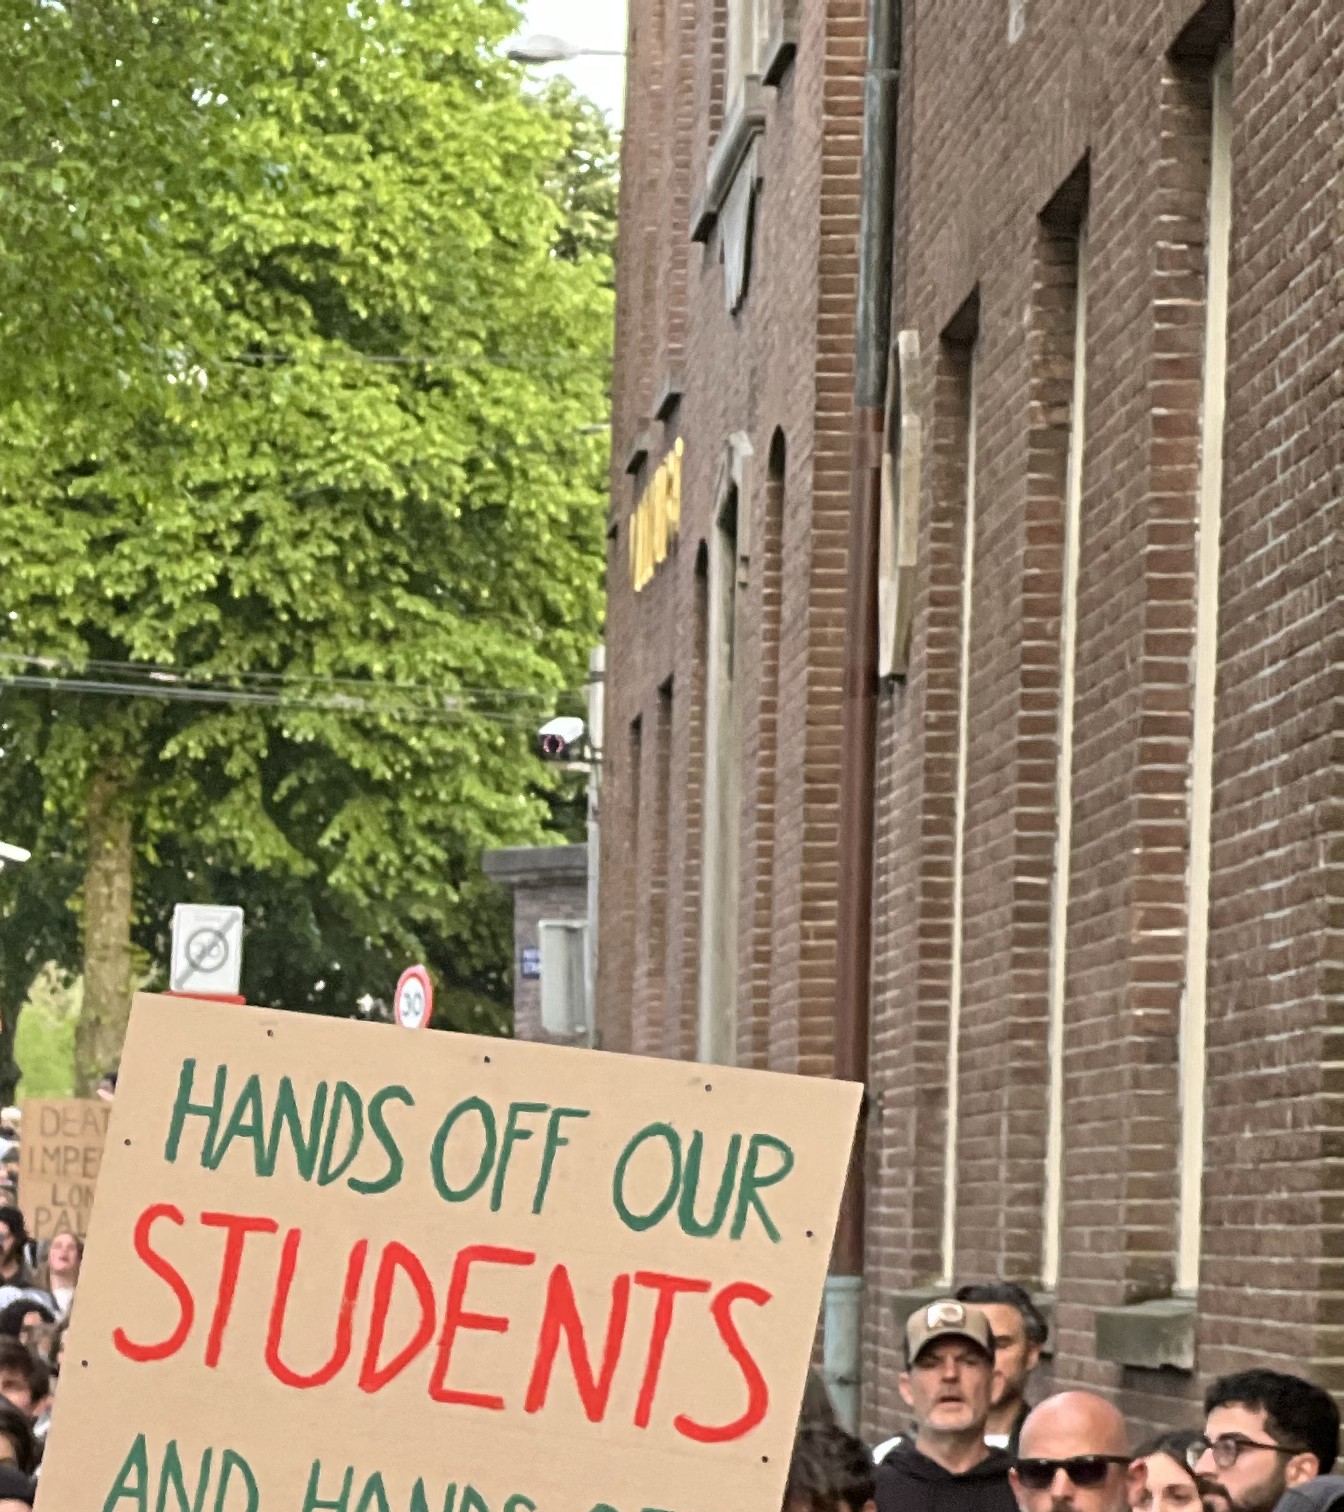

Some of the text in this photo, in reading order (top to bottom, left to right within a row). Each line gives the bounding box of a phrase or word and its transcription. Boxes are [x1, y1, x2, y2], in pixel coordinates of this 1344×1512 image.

[163, 1057, 796, 1244] HANDS OFF OUR
[110, 1201, 775, 1444] STUDENTS
